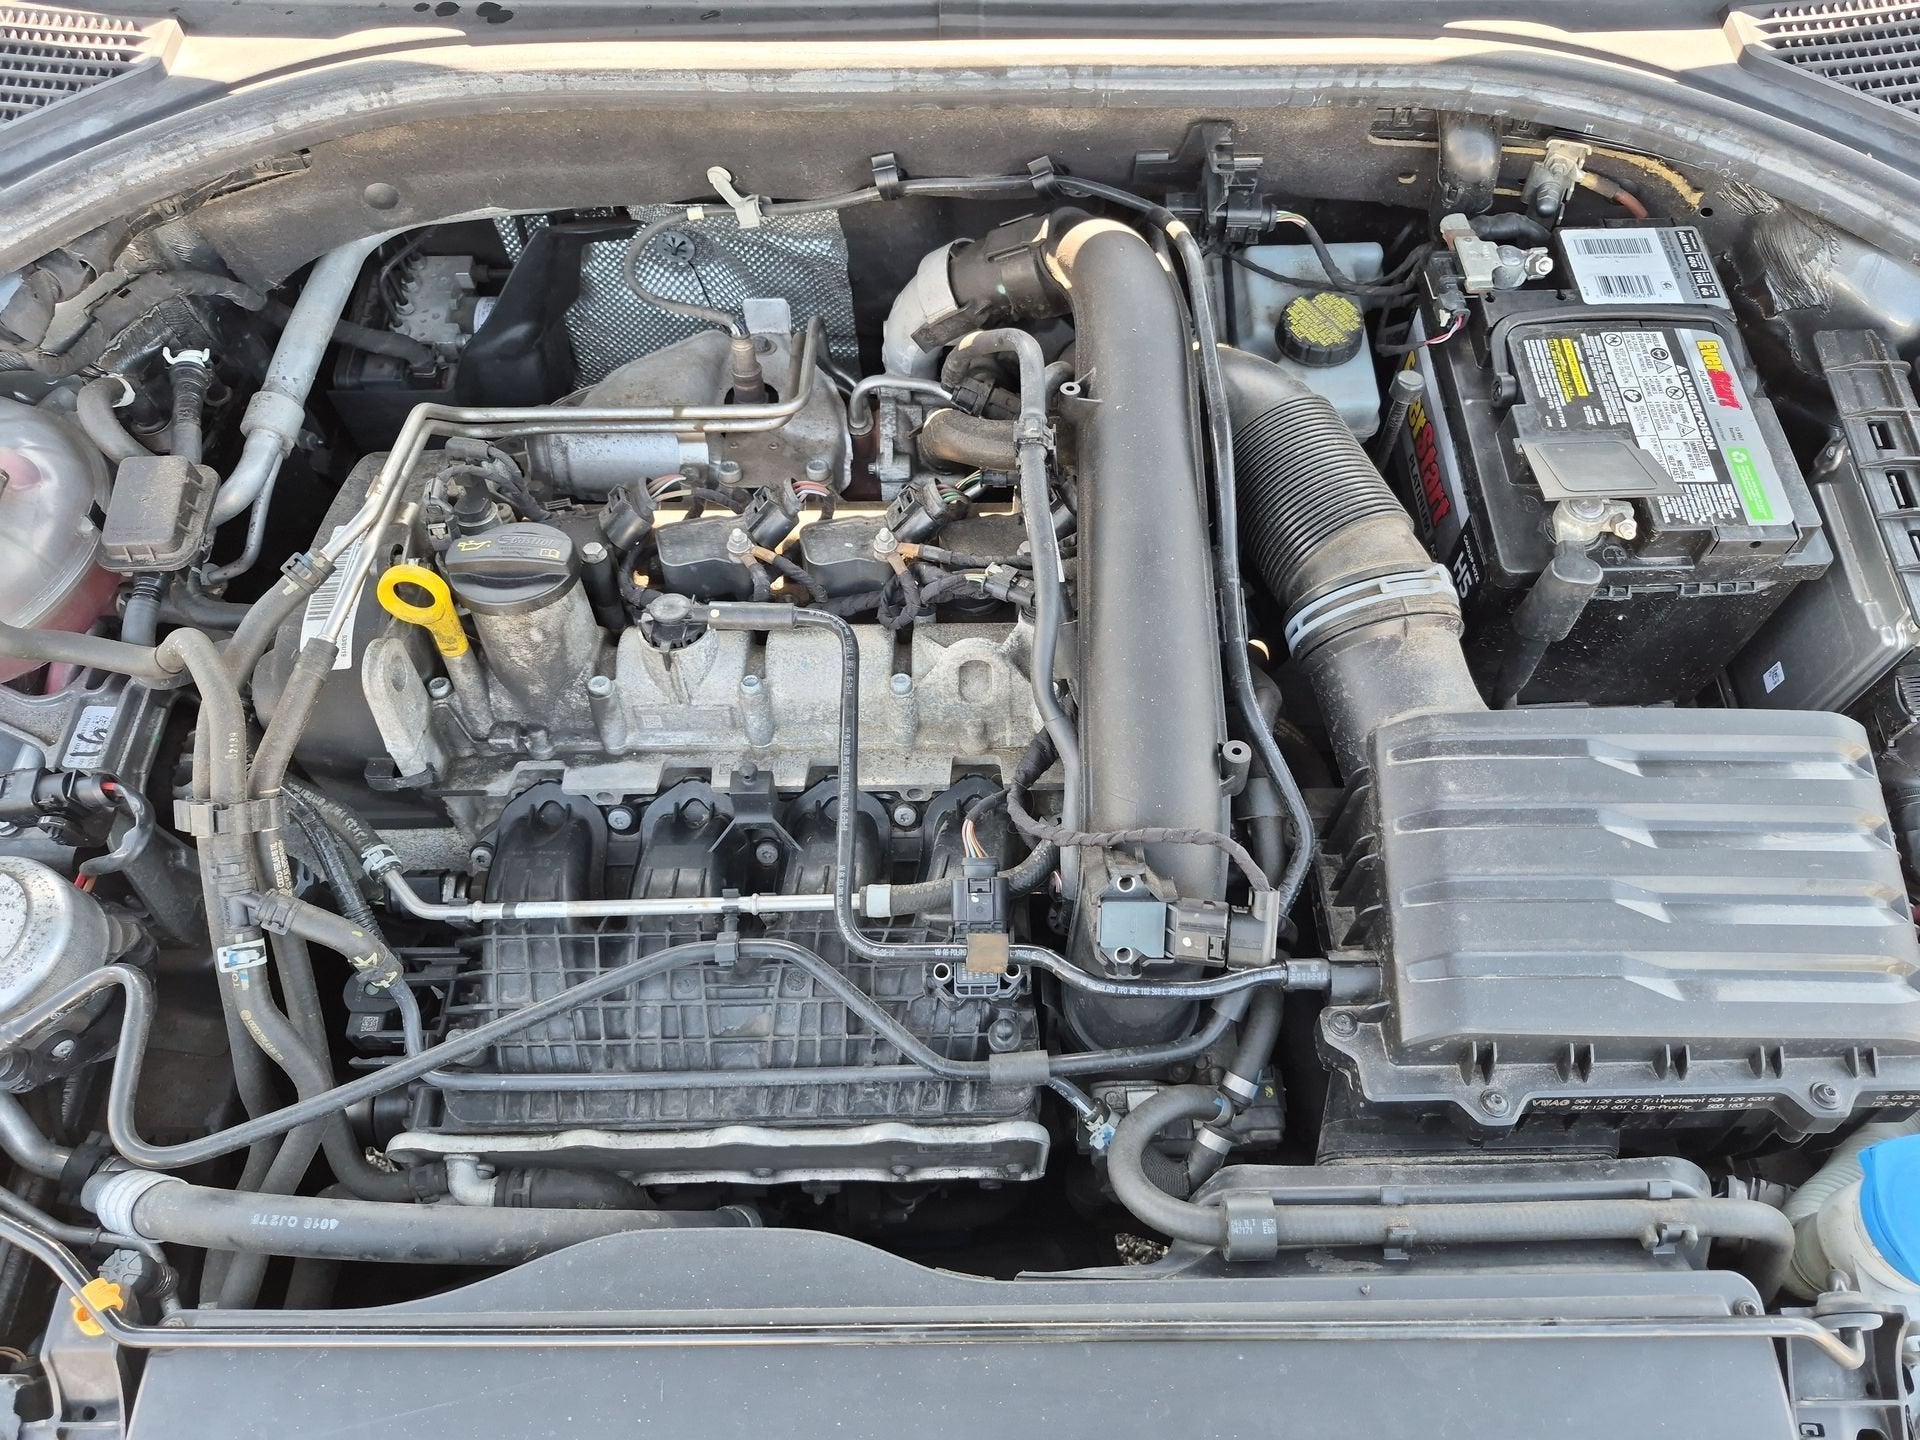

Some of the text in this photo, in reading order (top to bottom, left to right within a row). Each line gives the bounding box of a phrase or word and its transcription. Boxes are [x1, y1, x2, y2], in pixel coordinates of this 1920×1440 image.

[1676, 231, 1688, 244] AGM
[1682, 244, 1692, 252] H5
[1686, 255, 1698, 267] 600
[1693, 272, 1704, 283] 100
[1699, 287, 1709, 295] 60
[1650, 333, 1660, 346] SHIELD
[1695, 339, 1742, 408] EverStart
[1697, 369, 1716, 402] PLATINUM
[1680, 374, 1716, 450] DANGER/POISON
[1404, 352, 1450, 526] EerStart
[1696, 440, 1707, 454] FLUSH
[1666, 455, 1676, 465] HELP
[1689, 441, 1705, 470] IMMEDIATELY
[1675, 460, 1688, 479] MEDICAL
[1407, 455, 1431, 532] PLATINUM
[510, 536, 554, 546] Castrol
[1462, 534, 1481, 583] GROUP SIZE
[1450, 551, 1473, 599] H5
